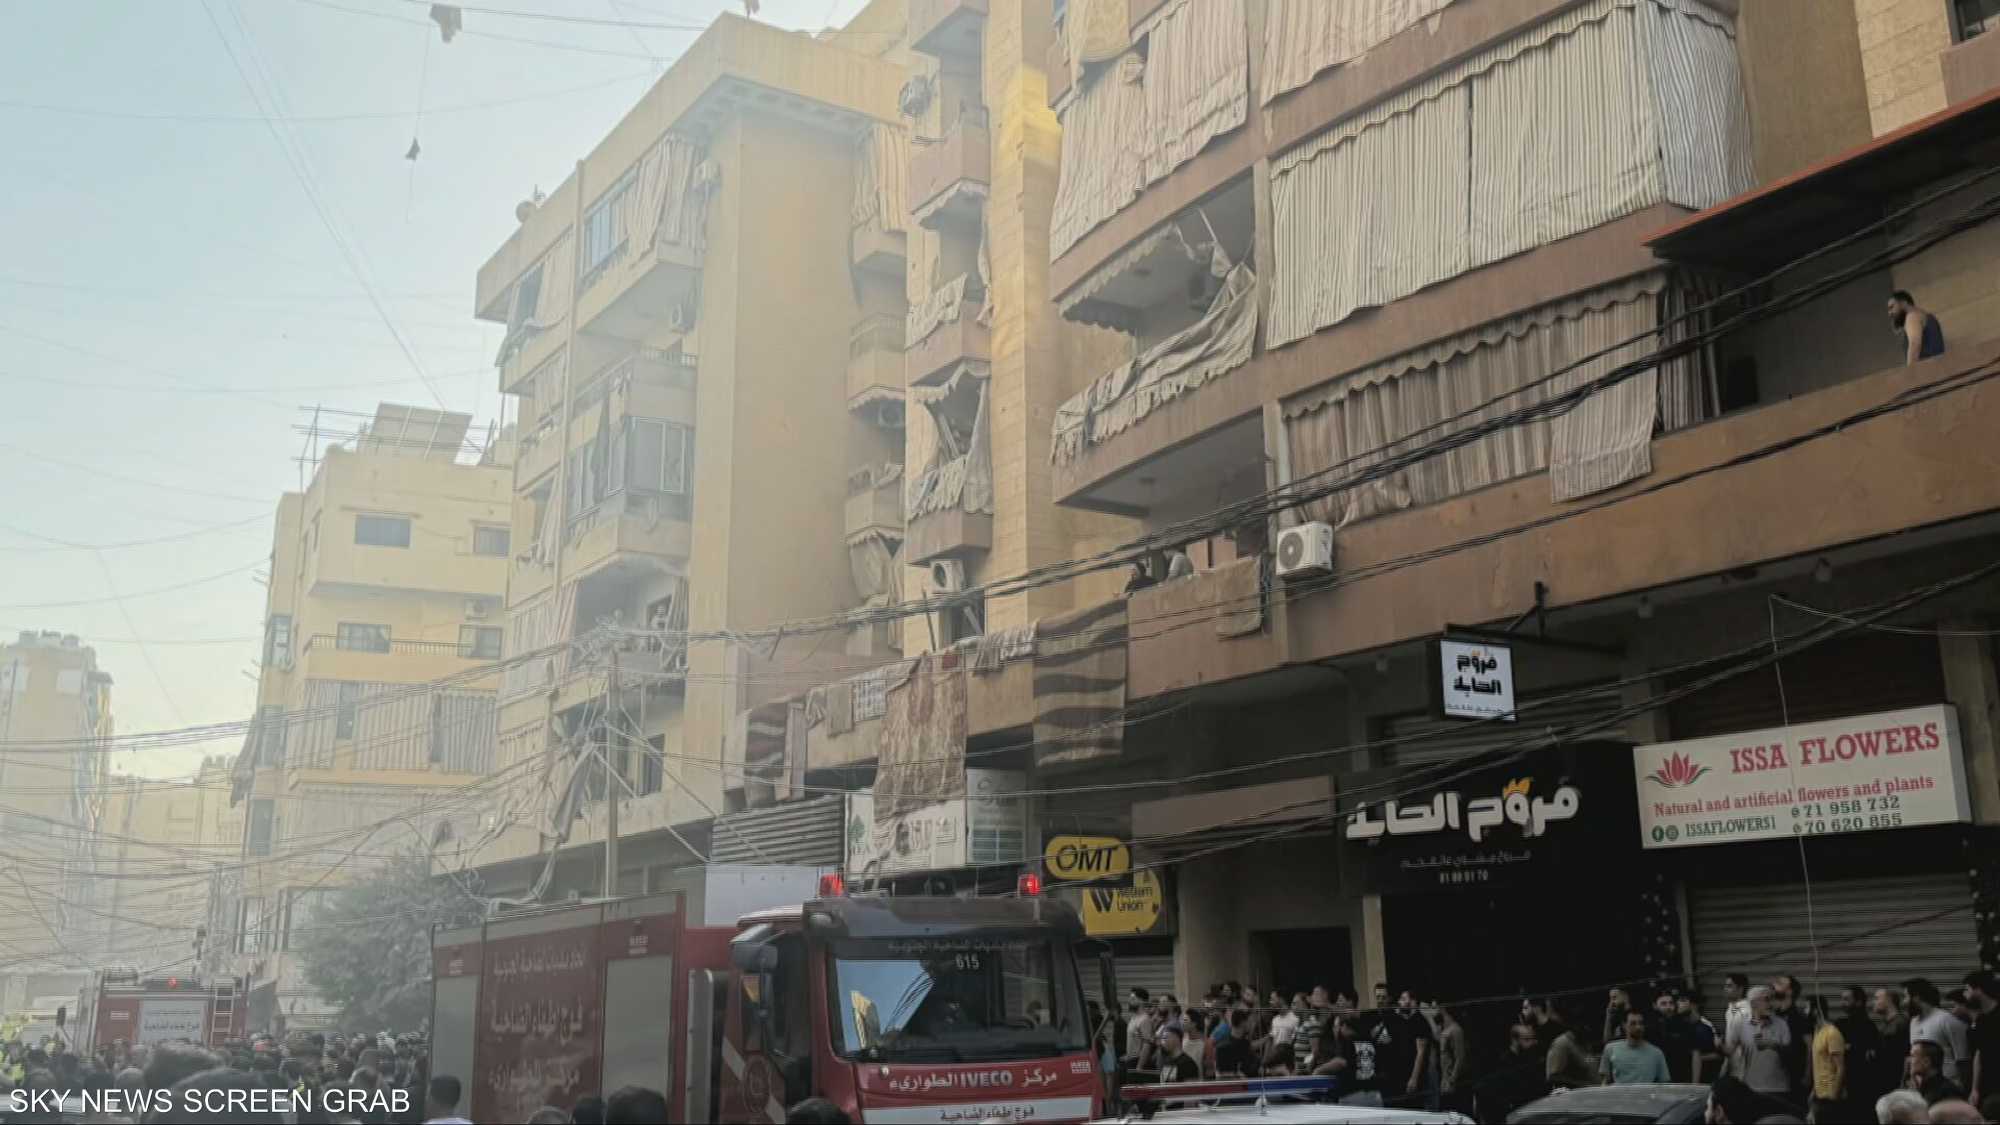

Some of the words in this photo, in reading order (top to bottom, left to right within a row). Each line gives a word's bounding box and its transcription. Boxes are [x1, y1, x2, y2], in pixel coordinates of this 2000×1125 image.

[1730, 744, 1788, 774] ISSA
[1799, 722, 1940, 767] FLOWERS
[1654, 801, 1703, 818] Natural
[1706, 796, 1730, 812] and
[1734, 788, 1793, 810] artificial
[1798, 783, 1850, 803] flowers
[1853, 779, 1882, 796] and
[1886, 775, 1935, 796] plants
[1804, 803, 1823, 817] 71
[1830, 800, 1861, 815] 958
[1867, 795, 1900, 811] 732
[1804, 820, 1825, 834] 70
[1831, 817, 1863, 832] 620
[1869, 813, 1902, 829] 855
[1056, 844, 1118, 872] OMT
[955, 952, 980, 970] 615
[960, 1070, 1013, 1088] IVECO
[1021, 1067, 1057, 1088] مركز
